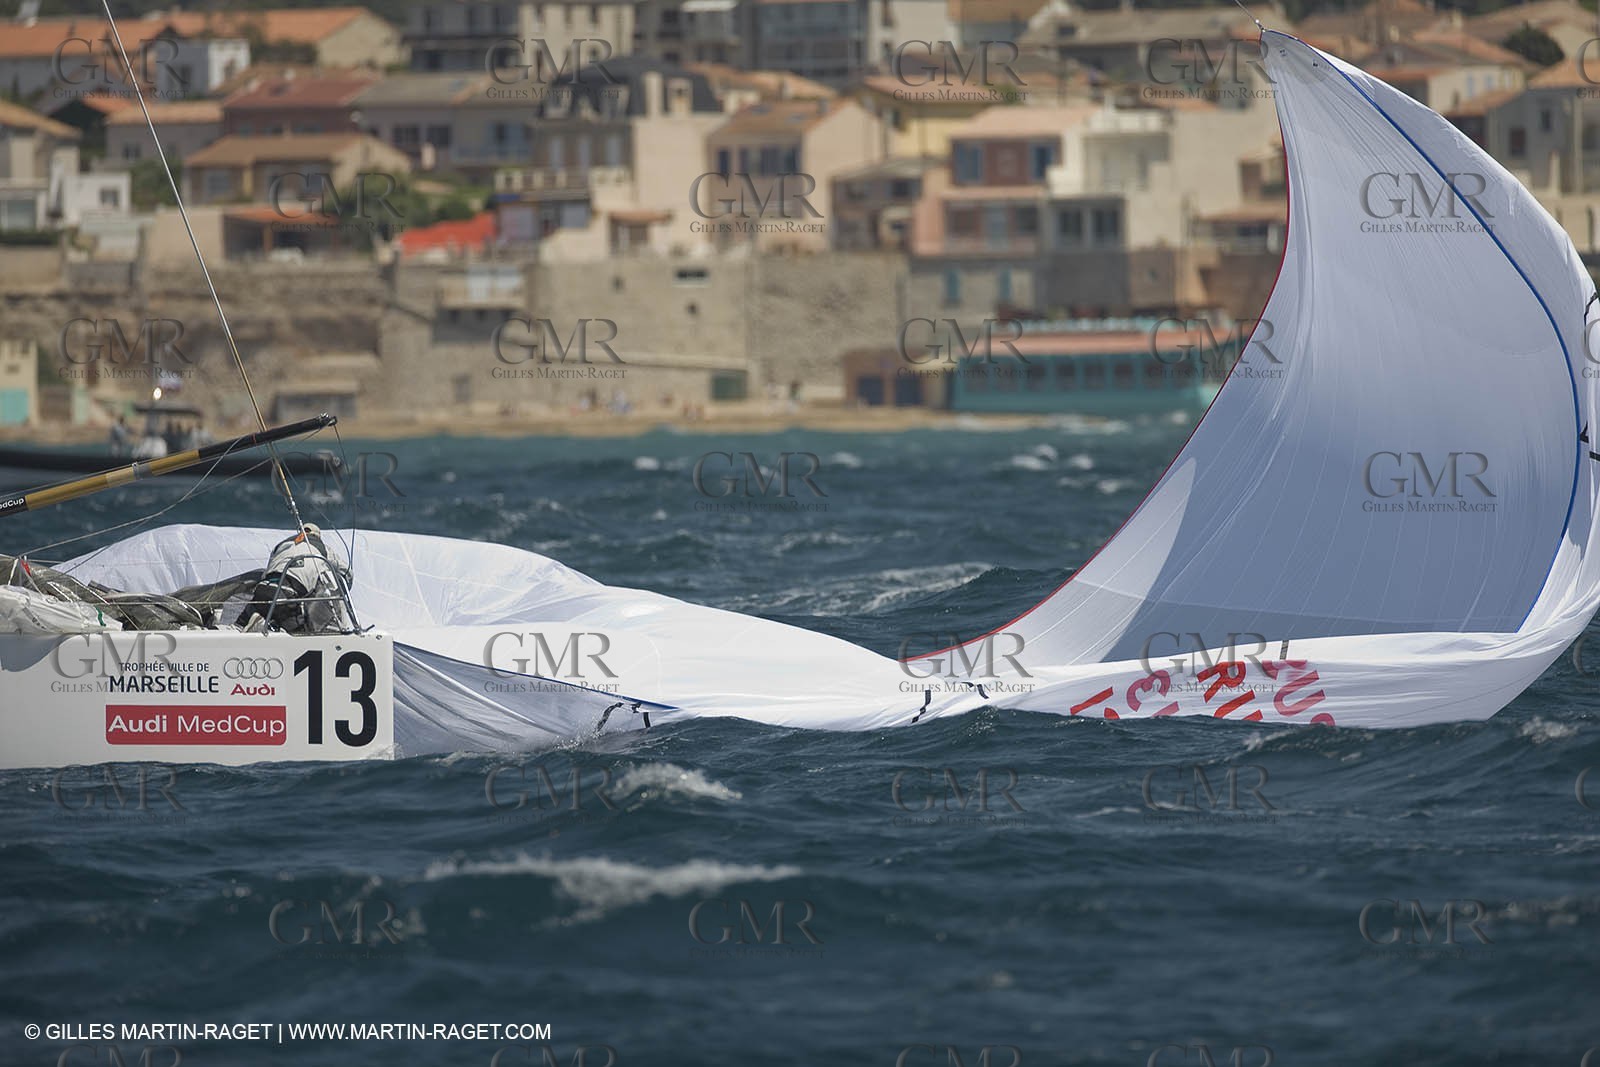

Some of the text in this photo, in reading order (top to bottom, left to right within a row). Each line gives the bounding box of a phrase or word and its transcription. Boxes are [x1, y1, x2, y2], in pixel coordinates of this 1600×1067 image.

[118, 661, 209, 672] TROPHÉE VILLE DE
[109, 675, 219, 693] MARSEILLE
[230, 683, 275, 696] Audi
[293, 650, 378, 747] 13
[108, 714, 284, 737] Audi MedCup
